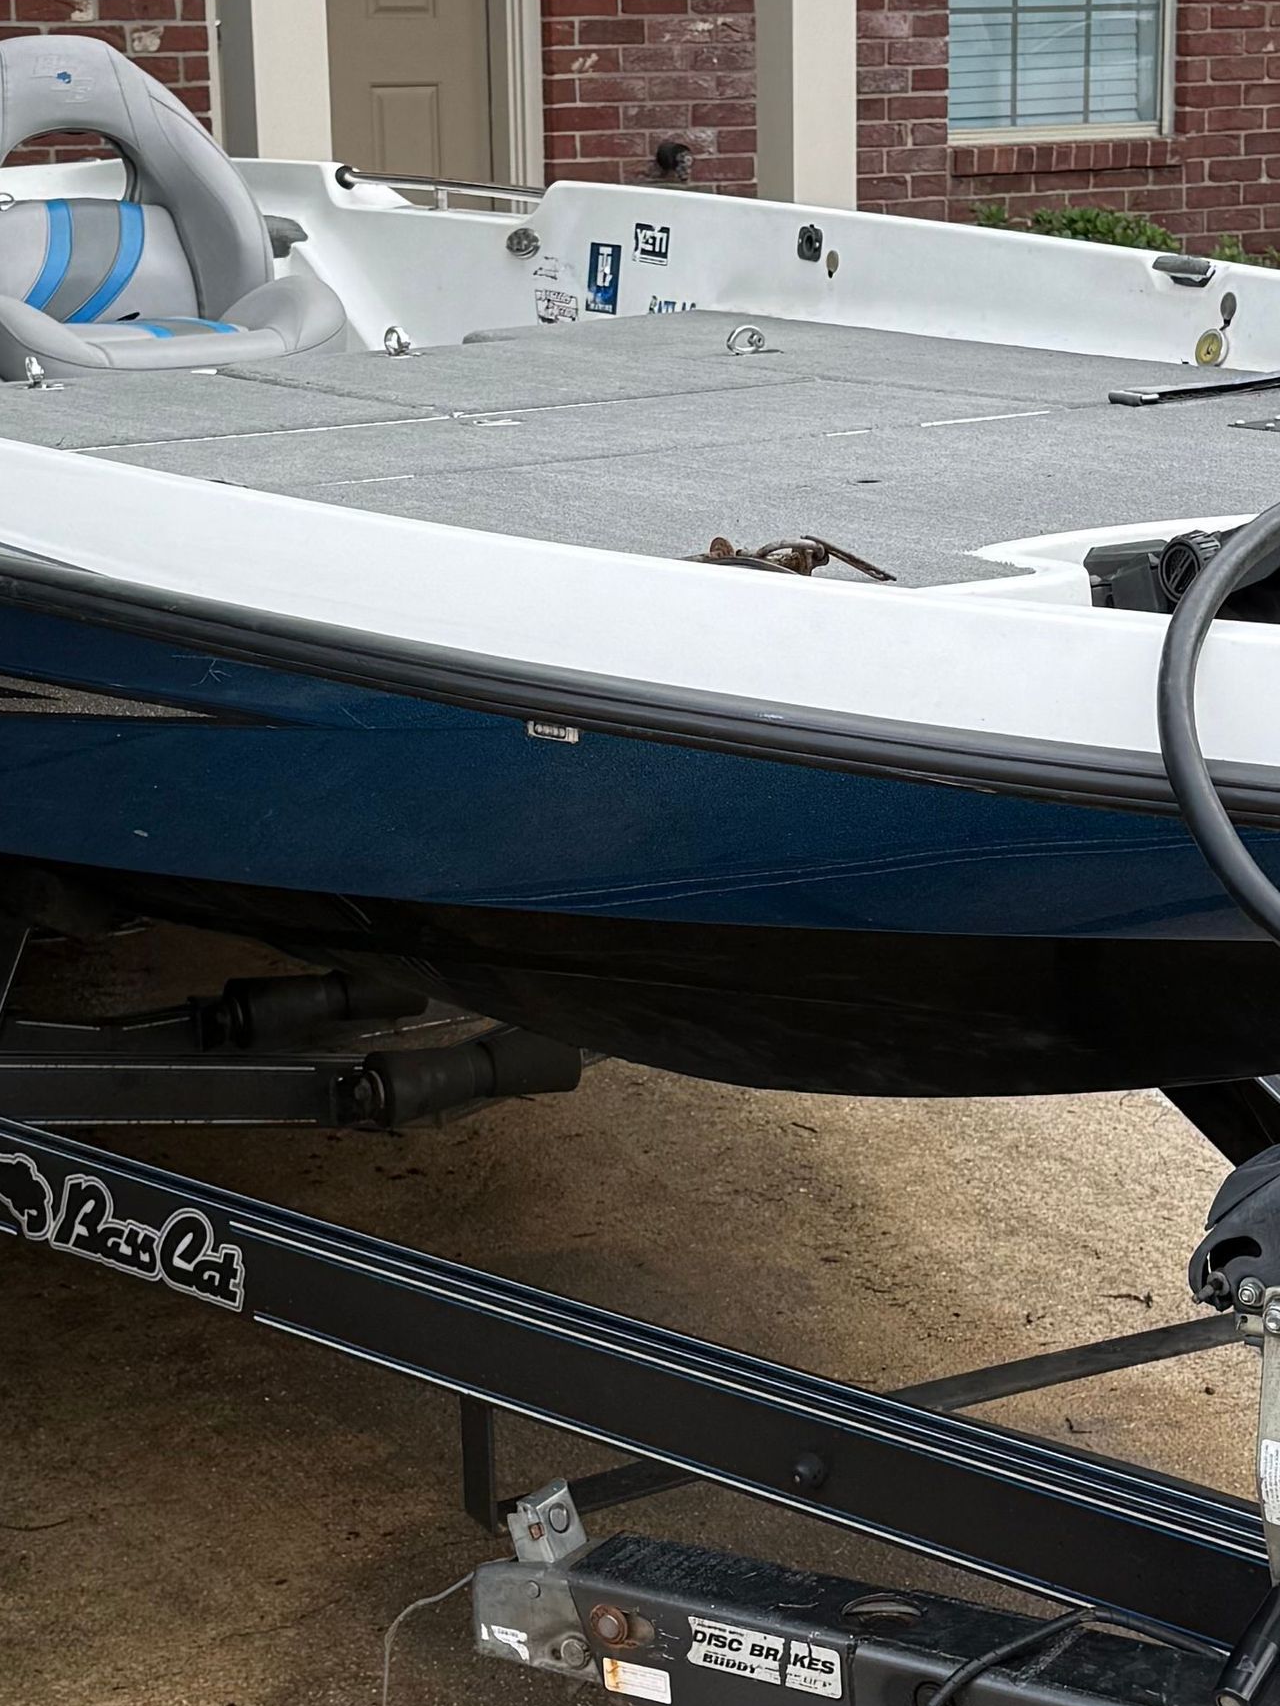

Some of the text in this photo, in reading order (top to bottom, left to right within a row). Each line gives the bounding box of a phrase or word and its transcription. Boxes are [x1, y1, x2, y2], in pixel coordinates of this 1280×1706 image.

[636, 228, 668, 253] YETI
[693, 1629, 743, 1652] DISC
[749, 1643, 835, 1675] BRKES
[702, 1653, 760, 1674] BUDDY
